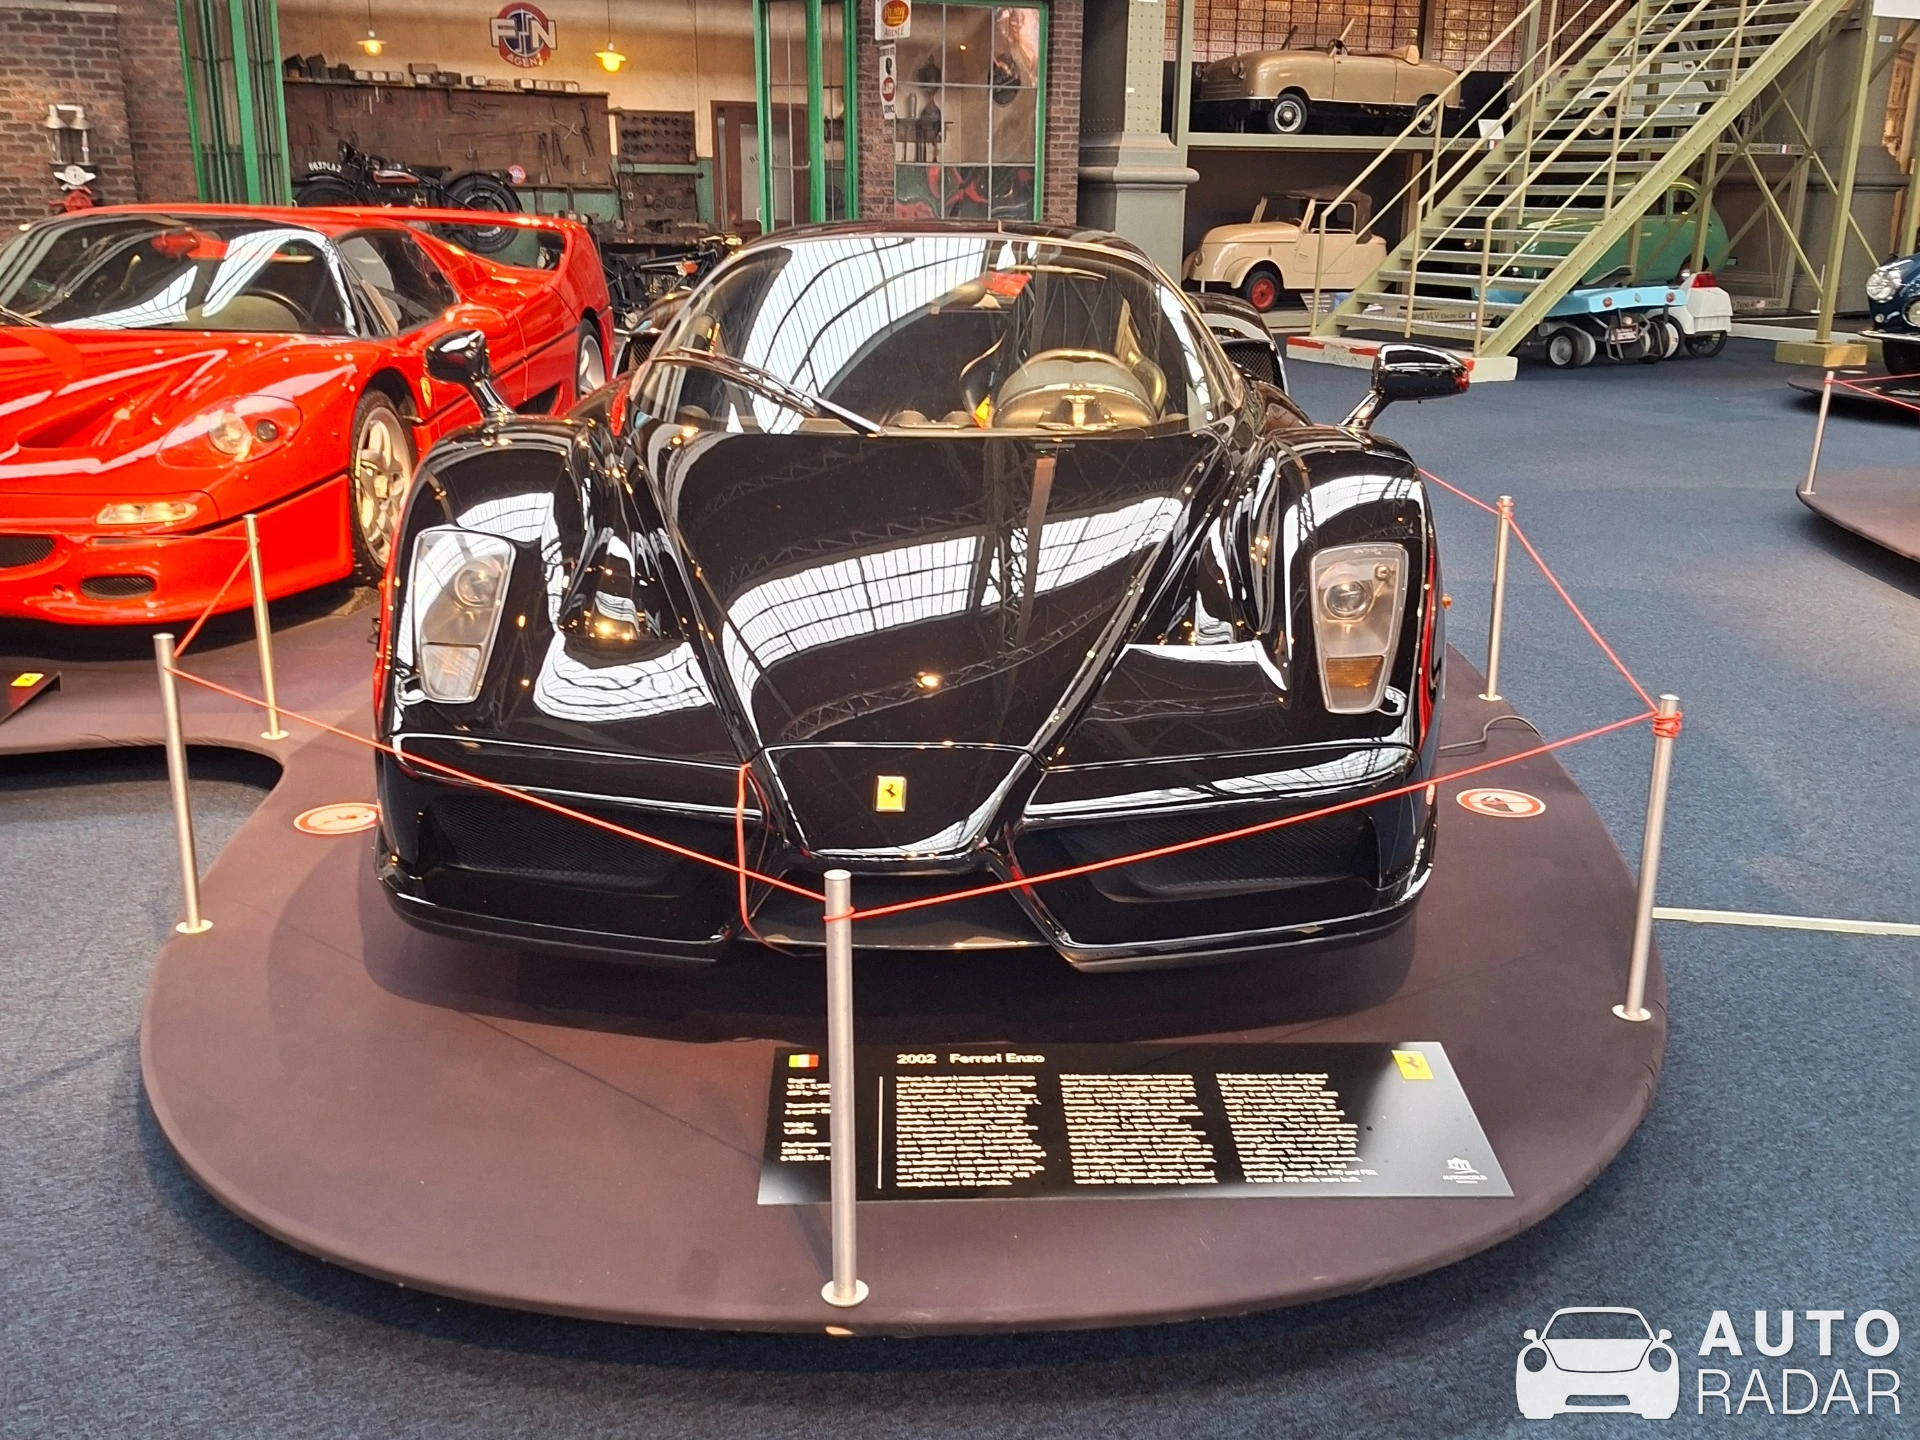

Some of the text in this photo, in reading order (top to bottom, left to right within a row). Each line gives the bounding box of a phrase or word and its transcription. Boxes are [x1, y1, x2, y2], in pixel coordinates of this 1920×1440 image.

[896, 1053, 1046, 1065] 2002 Ferrari Enzo
